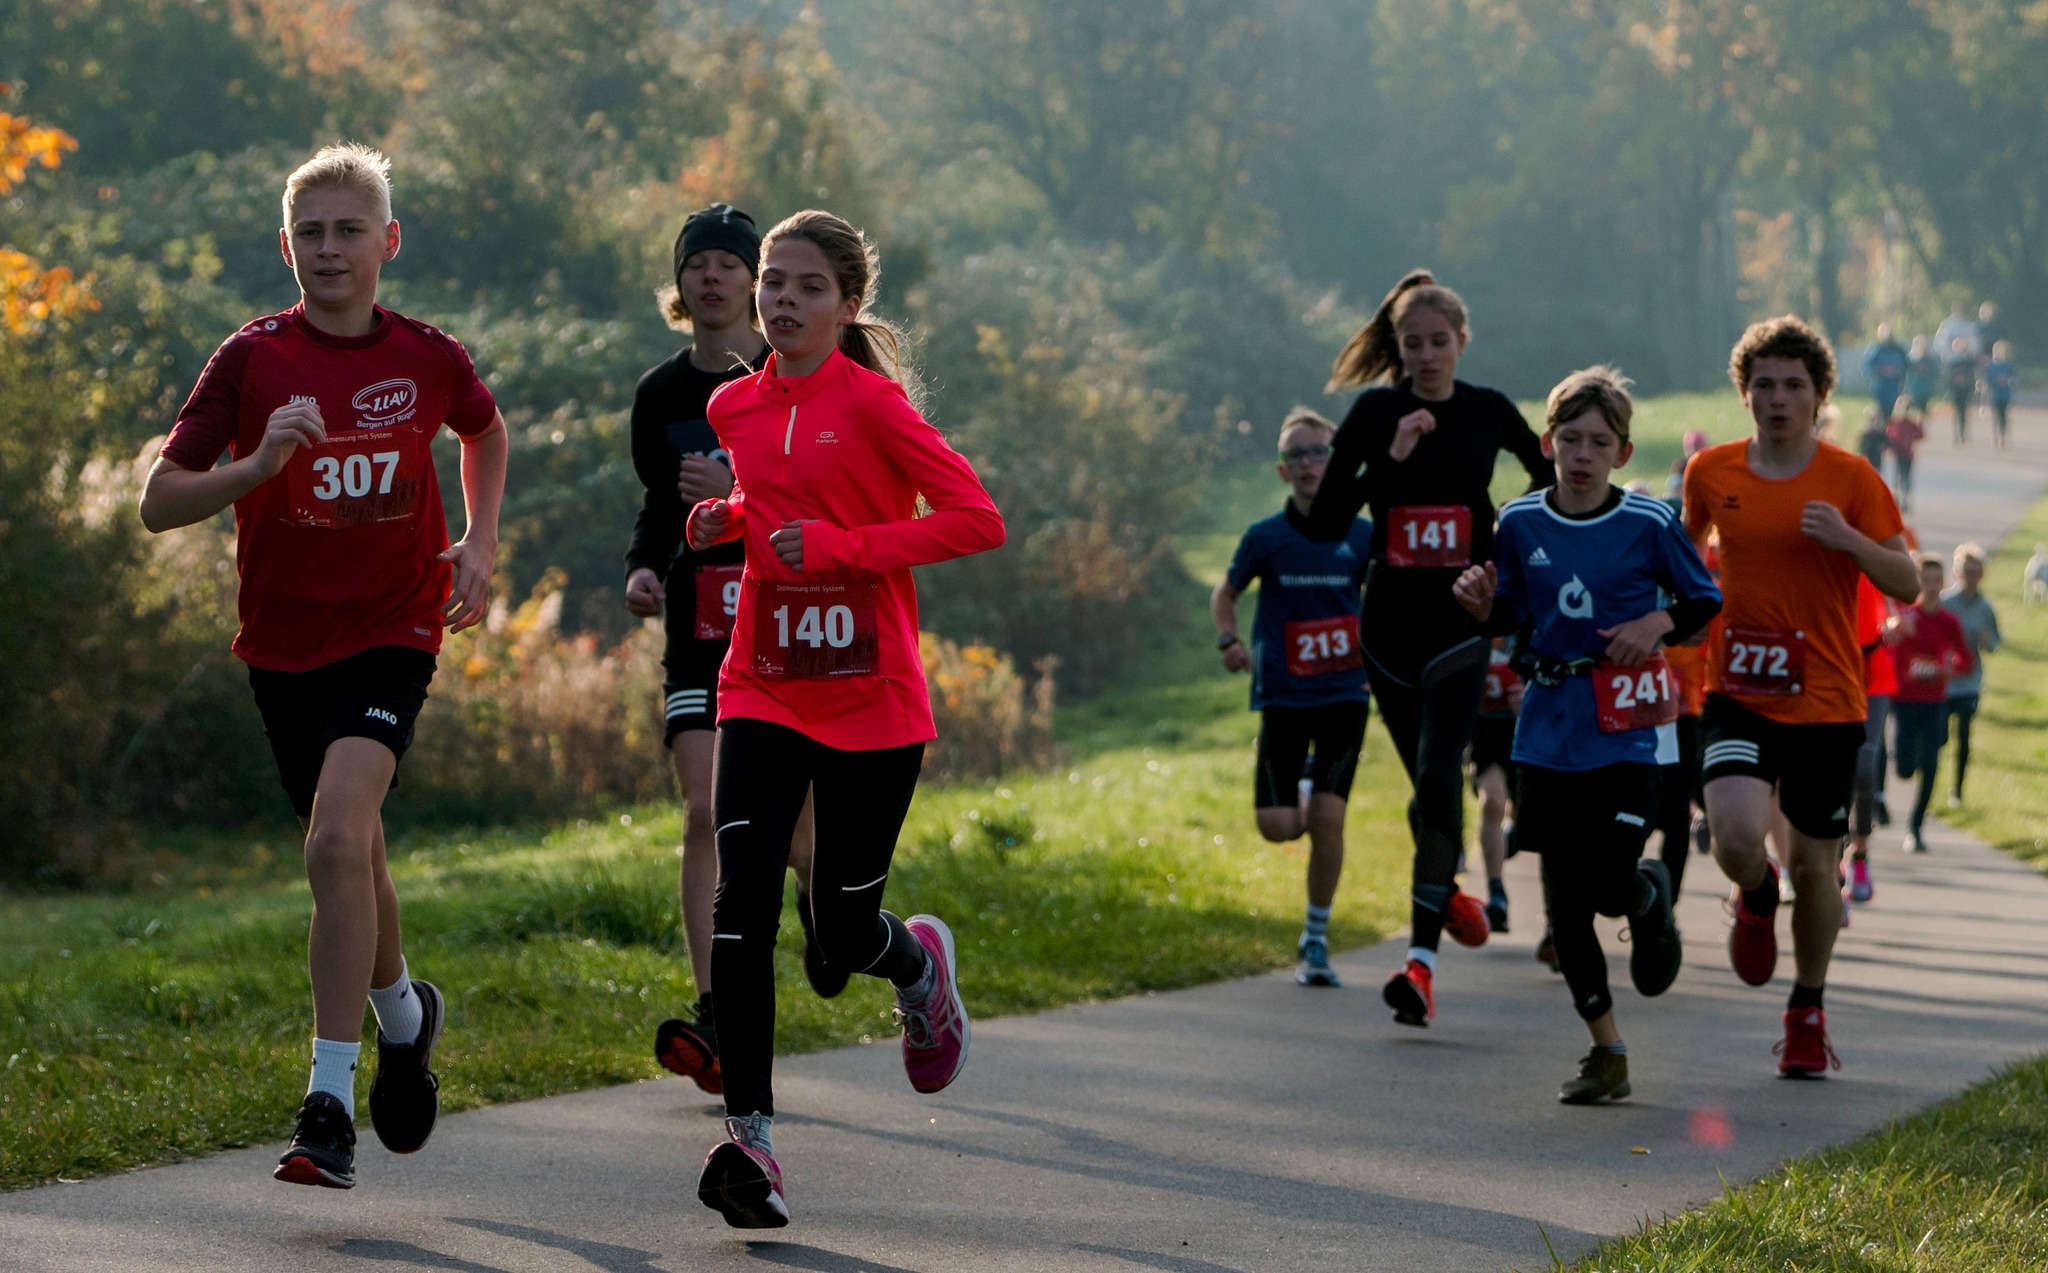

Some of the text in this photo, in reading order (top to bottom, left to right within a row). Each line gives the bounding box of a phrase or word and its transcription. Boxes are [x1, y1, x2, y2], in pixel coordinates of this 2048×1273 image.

[289, 394, 317, 406] JAKO
[356, 408, 417, 429] Bergen auf Rügen
[326, 435, 356, 443] tmessung
[370, 432, 393, 440] System
[313, 450, 400, 500] 307
[1402, 519, 1457, 550] 141
[776, 584, 845, 593] Zeitmessung mit System
[773, 604, 854, 648] 140
[1297, 629, 1350, 661] 213
[1728, 642, 1789, 677] 272
[1611, 667, 1670, 709] 241
[365, 707, 398, 725] JAKO
